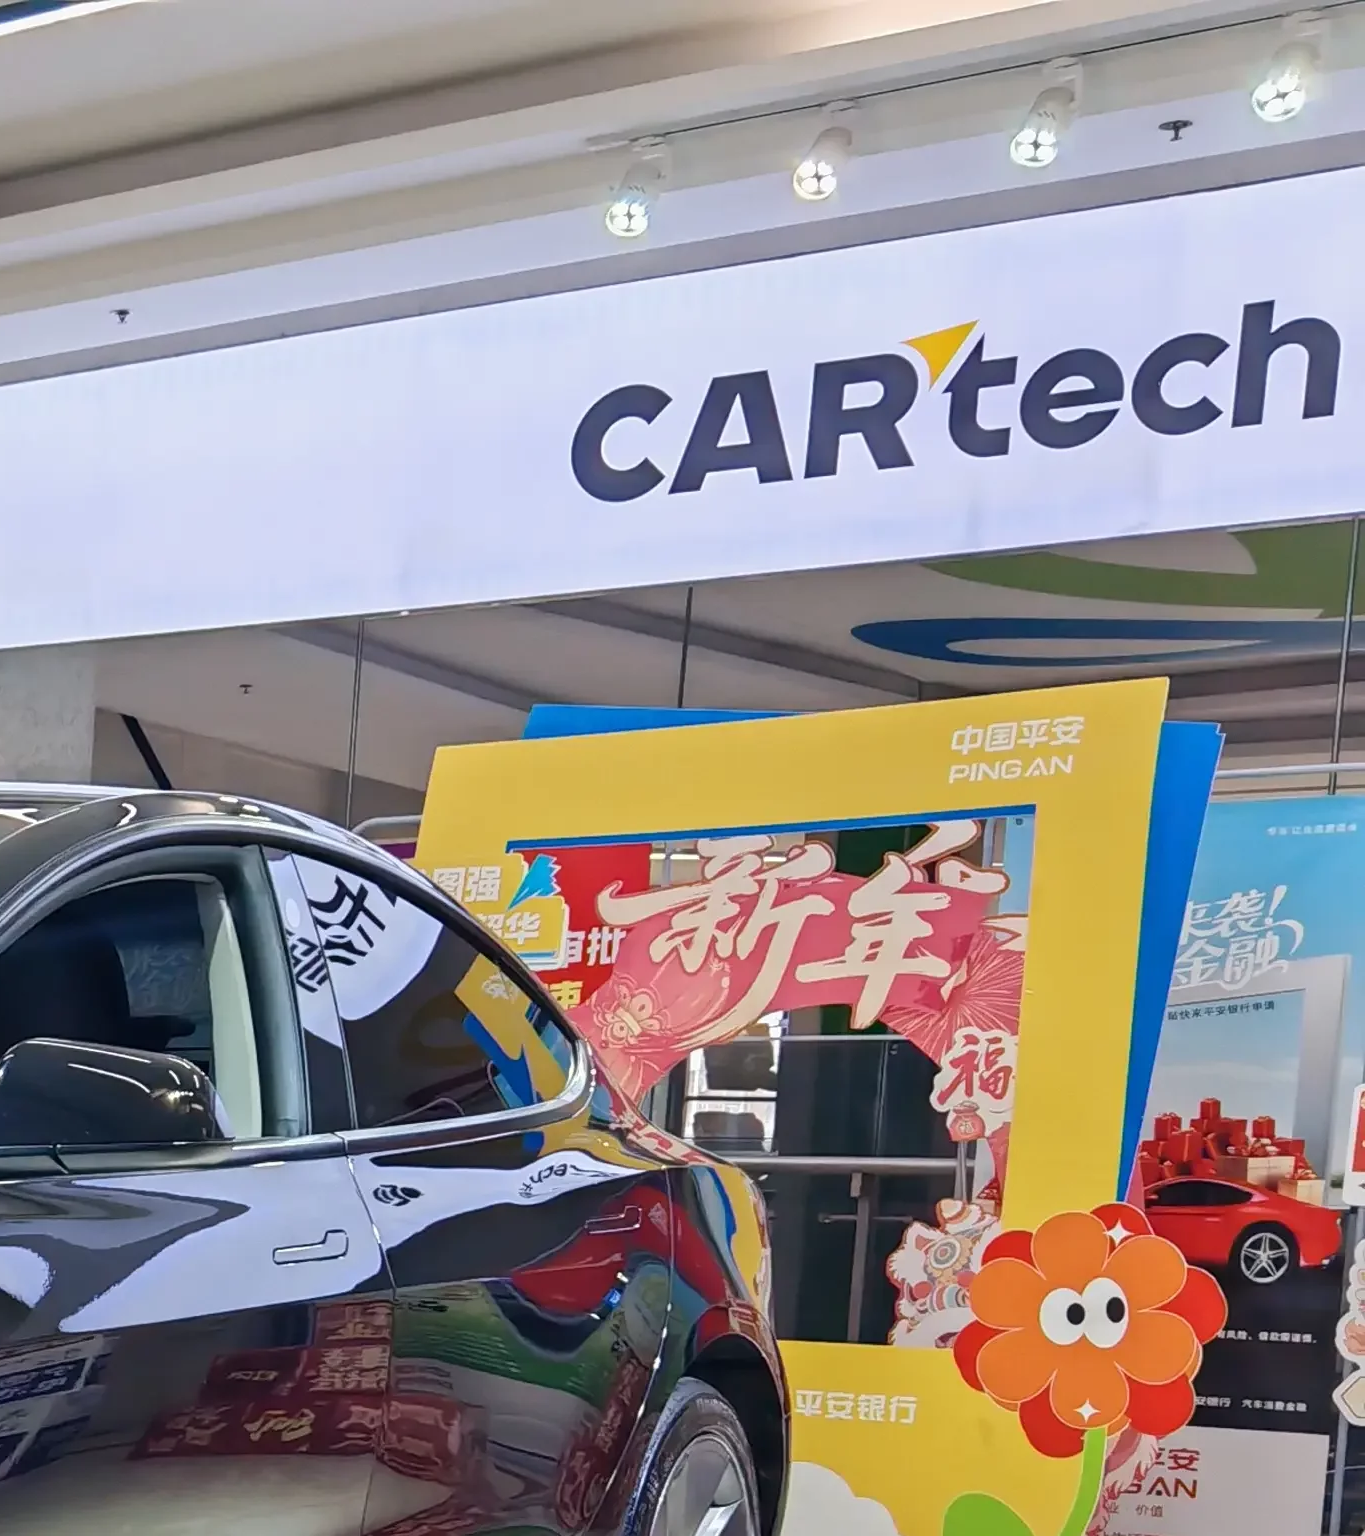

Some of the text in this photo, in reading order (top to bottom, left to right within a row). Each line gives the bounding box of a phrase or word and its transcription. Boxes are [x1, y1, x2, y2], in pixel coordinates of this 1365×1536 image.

[571, 300, 1342, 503] CARtech
[951, 716, 1085, 755] 中国平安
[1171, 930, 1289, 991] 金融
[936, 1034, 1013, 1105] 福
[795, 1389, 918, 1425] 平安银行
